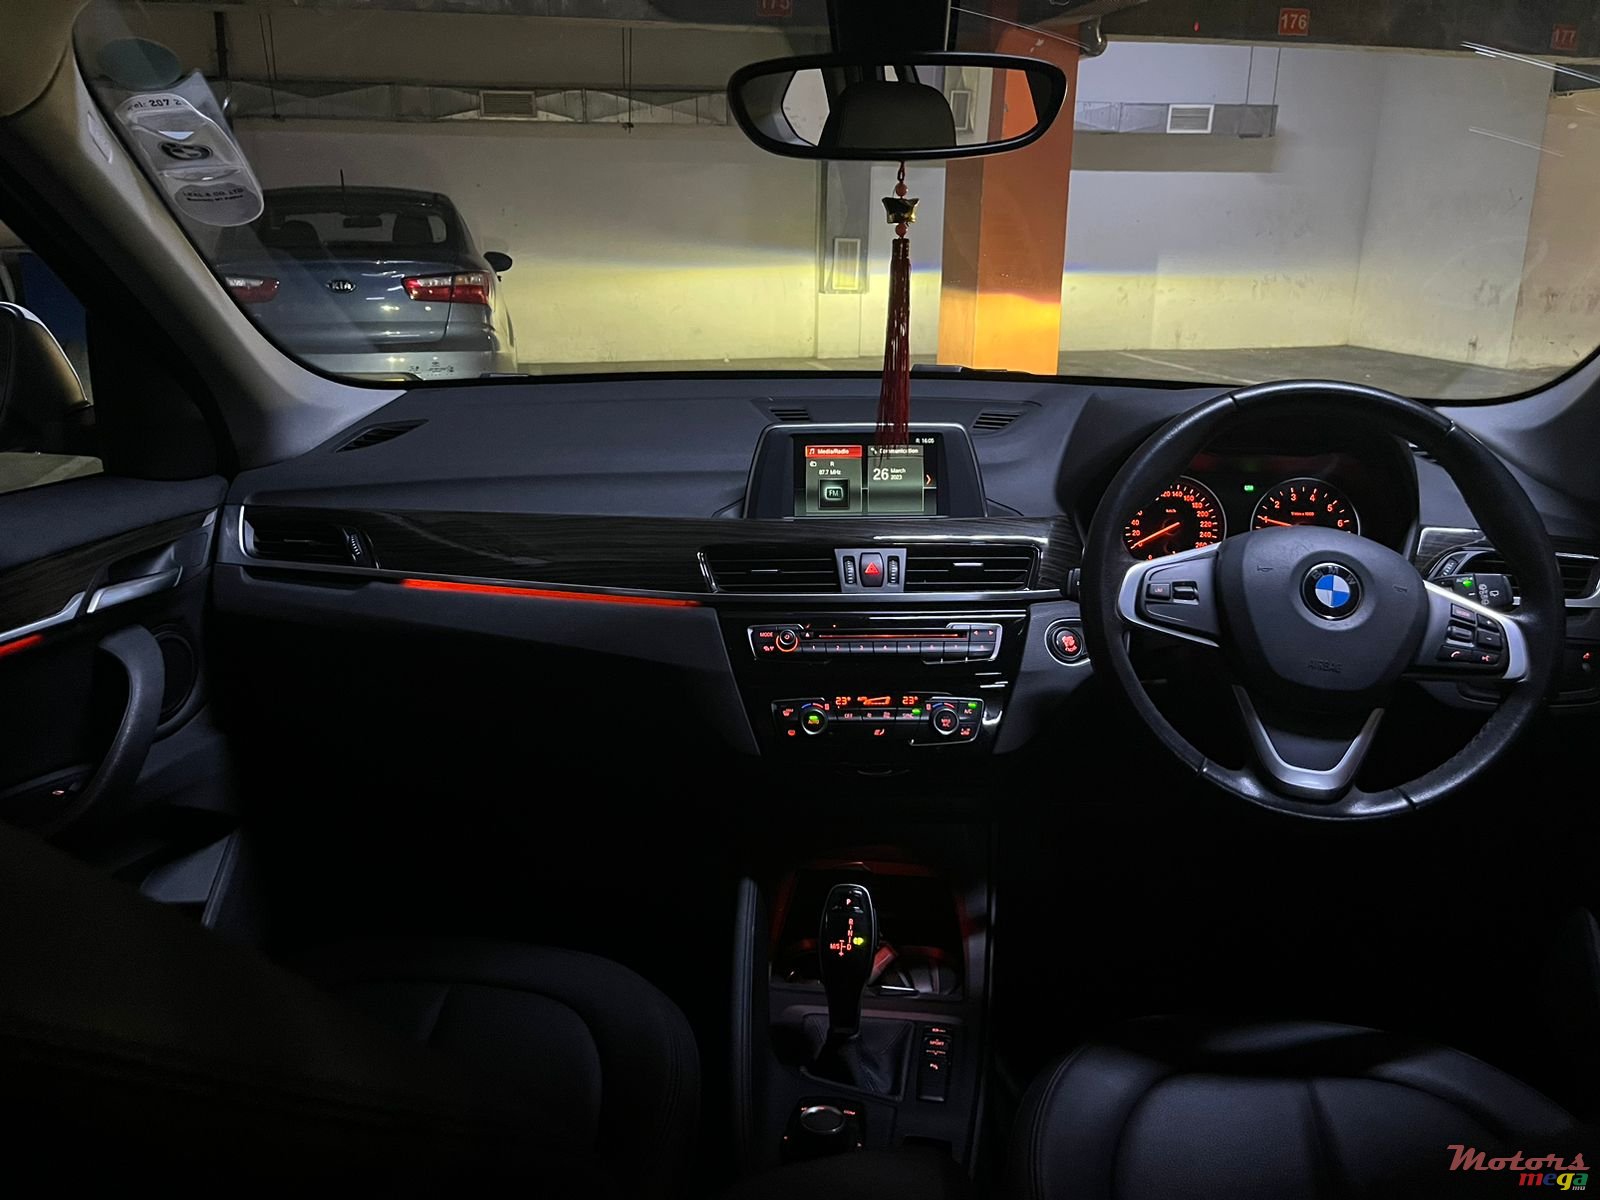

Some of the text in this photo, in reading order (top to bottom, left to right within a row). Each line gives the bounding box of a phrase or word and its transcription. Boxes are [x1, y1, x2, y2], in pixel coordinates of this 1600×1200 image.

[1281, 13, 1307, 30] 176
[1553, 28, 1577, 43] 177
[149, 98, 170, 107] 207
[331, 281, 352, 290] KIA
[872, 468, 890, 481] 26
[829, 489, 839, 497] FM
[1172, 490, 1183, 498] 140
[1290, 493, 1297, 502] 3
[1309, 494, 1316, 502] 4
[1274, 500, 1280, 509] 2
[1327, 503, 1334, 512] 5
[1196, 510, 1210, 518] 200
[1200, 520, 1213, 528] 220
[1337, 519, 1344, 528] 6
[1131, 529, 1141, 537] 20
